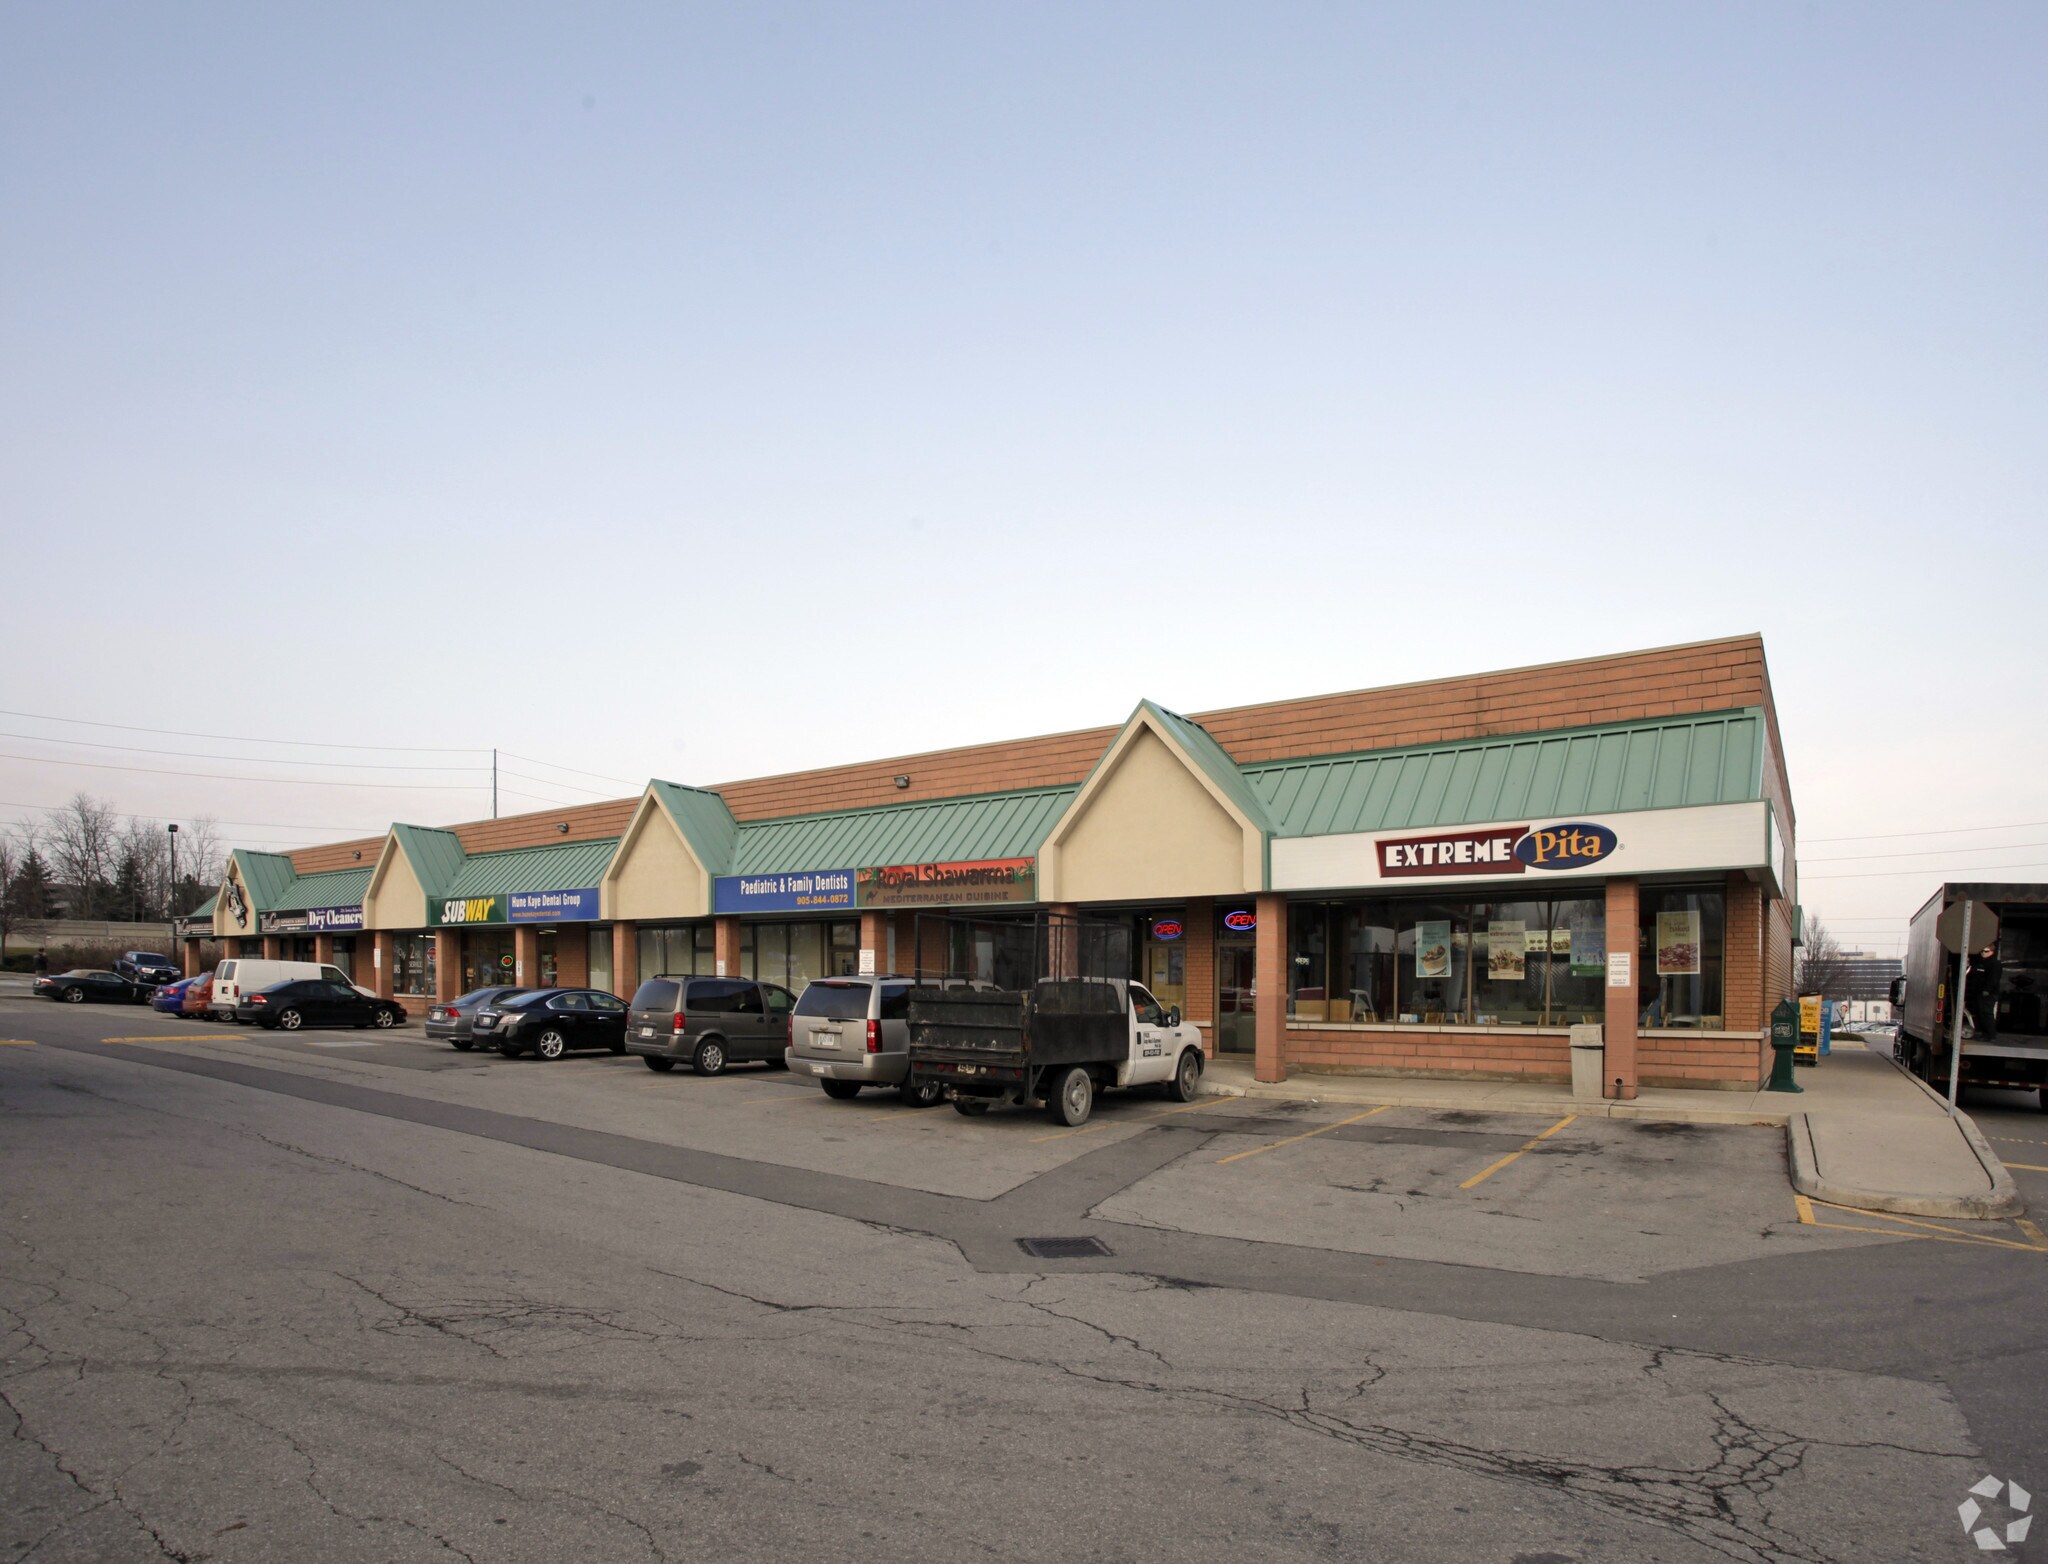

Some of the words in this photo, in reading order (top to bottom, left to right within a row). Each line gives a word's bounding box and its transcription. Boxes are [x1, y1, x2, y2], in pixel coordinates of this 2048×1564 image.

[1385, 838, 1511, 868] EXTREME
[1530, 828, 1603, 864] Pita
[740, 879, 778, 895] Paediatric
[780, 878, 786, 893] &
[788, 876, 813, 894] Family
[815, 874, 848, 891] Dentists
[876, 865, 920, 893] Royal
[923, 863, 1016, 888] Shawarma
[512, 896, 527, 908] Hune
[527, 895, 541, 909] Kaye
[542, 894, 562, 907] Dental
[562, 893, 581, 908] Group
[883, 893, 963, 904] MEDITERRANEAN
[309, 911, 326, 930] Dry
[326, 909, 363, 925] Cleaners
[441, 897, 495, 924] SUBWAY
[1227, 914, 1257, 926] OPEN
[1154, 923, 1183, 935] OPEN
